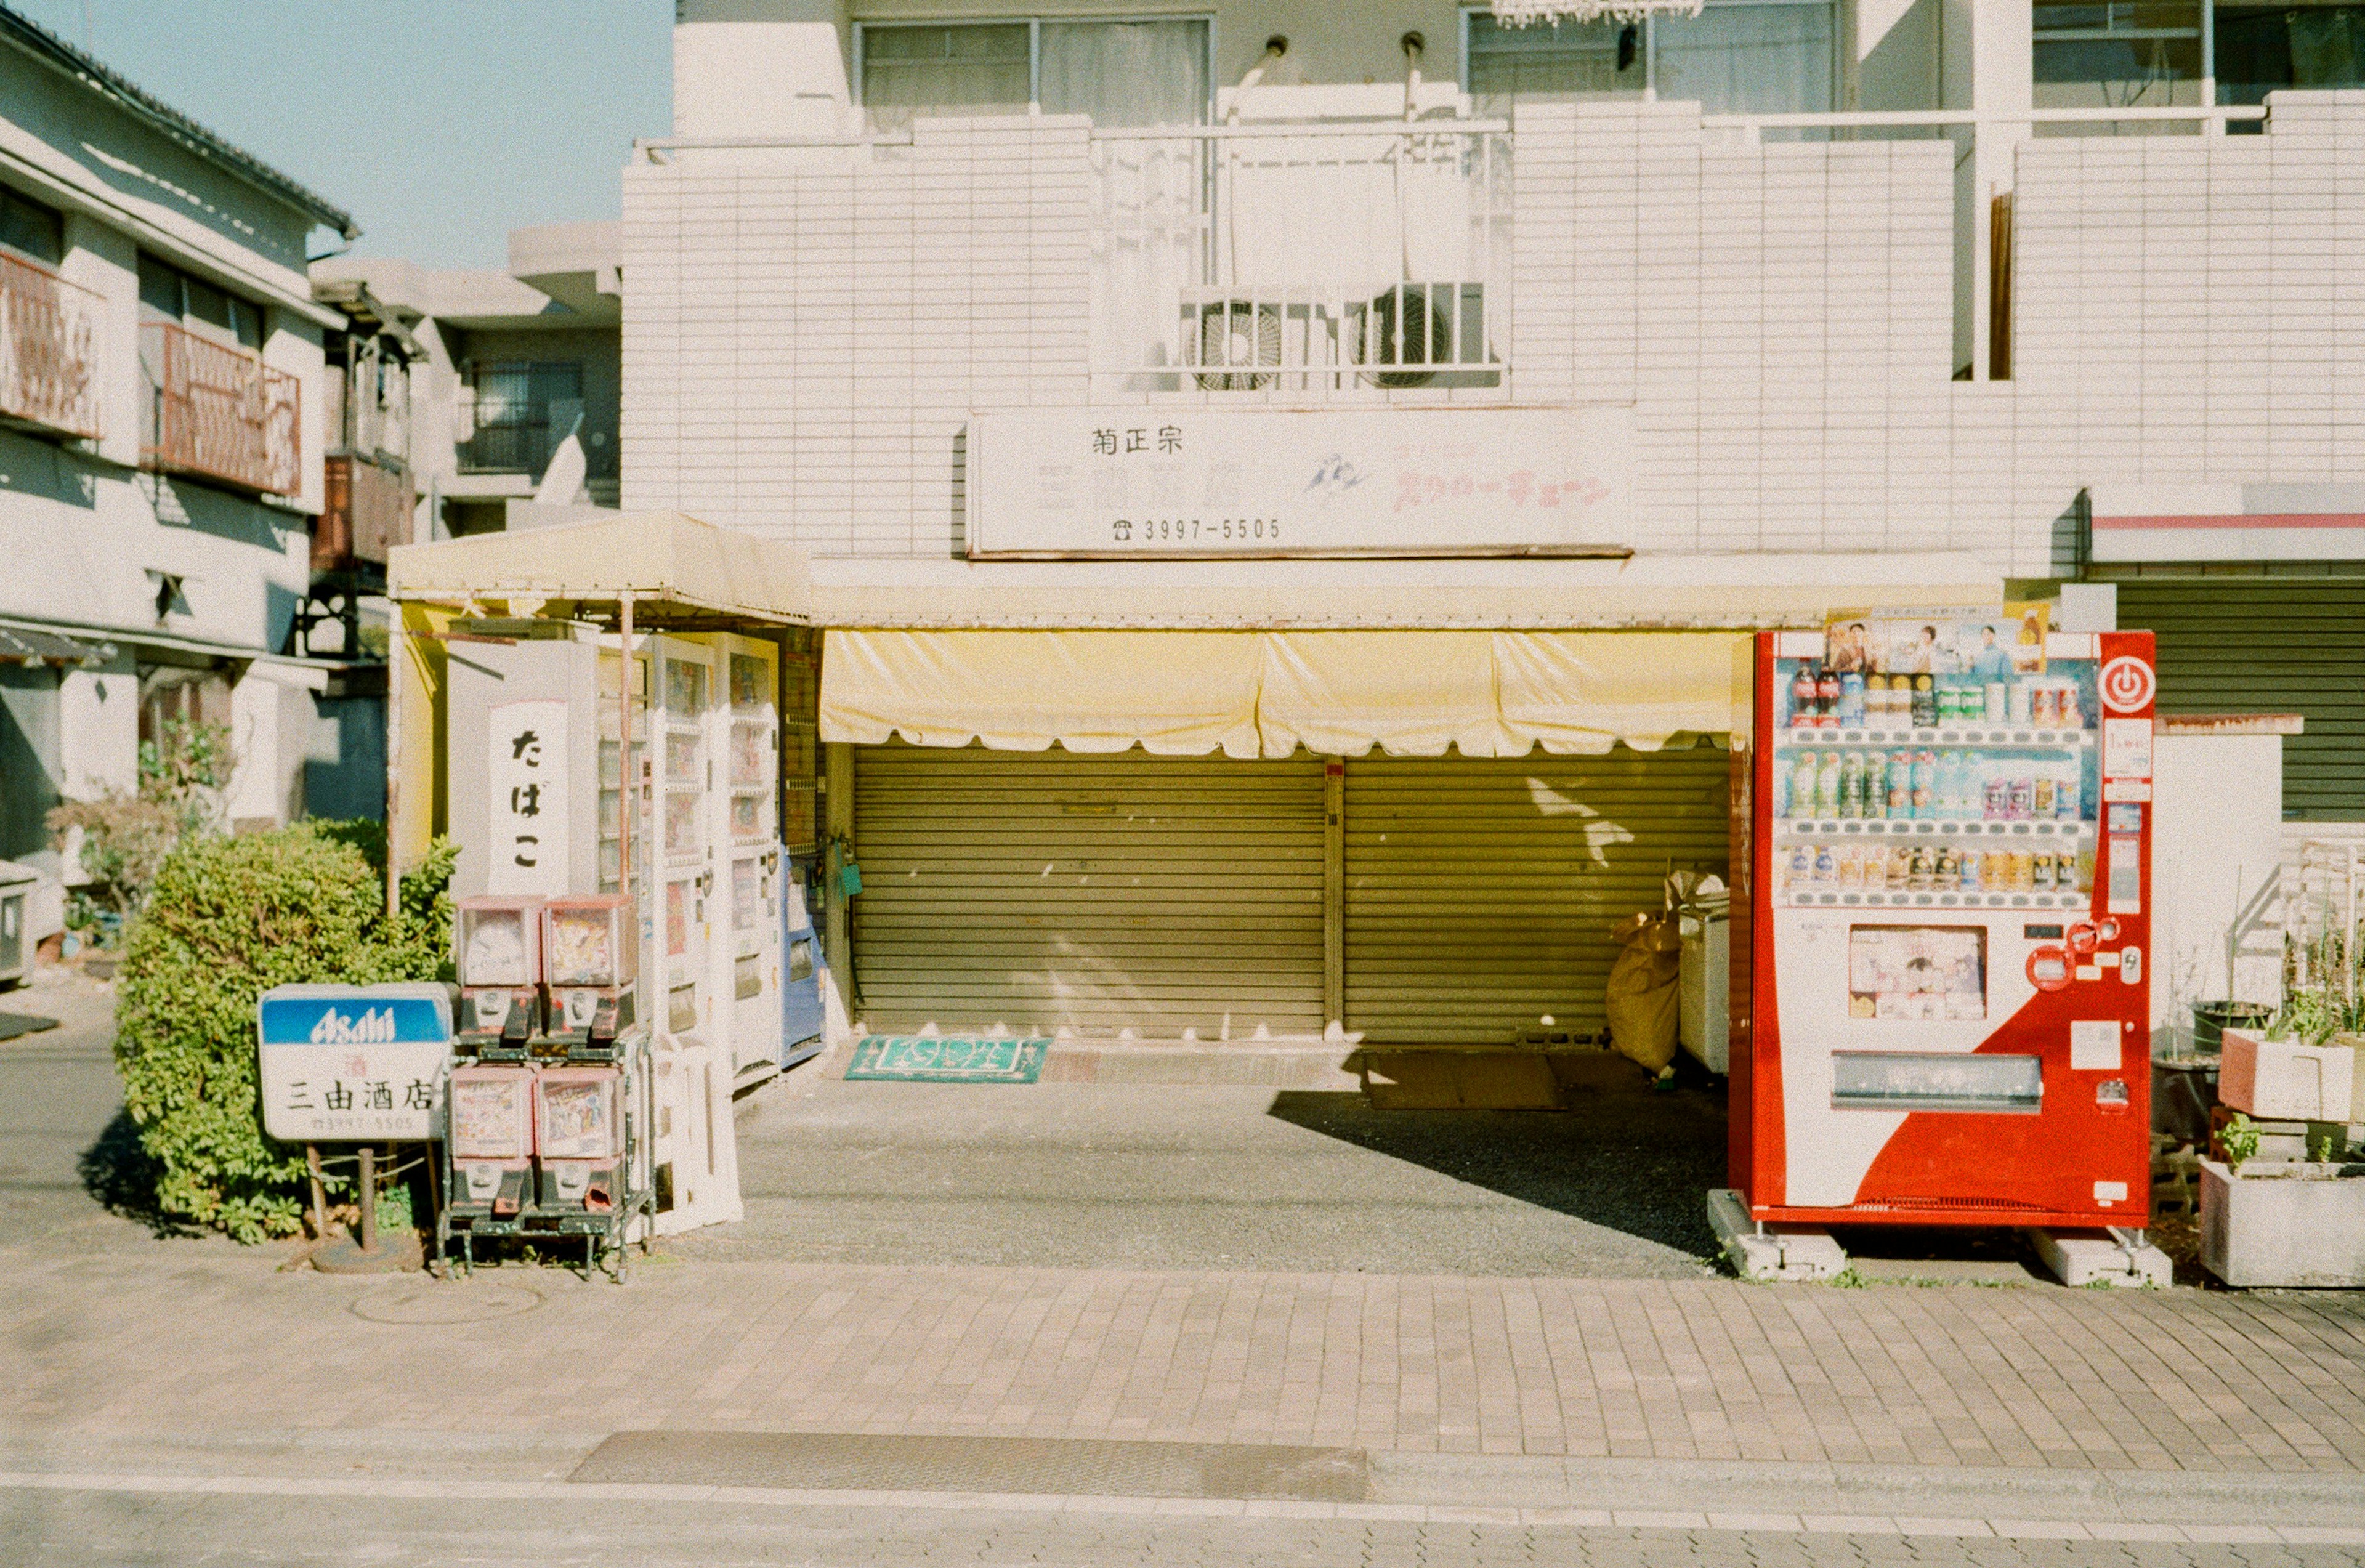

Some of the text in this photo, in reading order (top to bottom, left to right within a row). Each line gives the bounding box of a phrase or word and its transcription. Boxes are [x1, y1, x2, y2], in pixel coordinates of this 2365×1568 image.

[1092, 425, 1182, 455] 菊正宗
[1146, 519, 1279, 540] 3997-5505
[511, 730, 549, 868] たばこ
[310, 1006, 396, 1045] Asahi
[287, 1079, 432, 1110] 三由酒店
